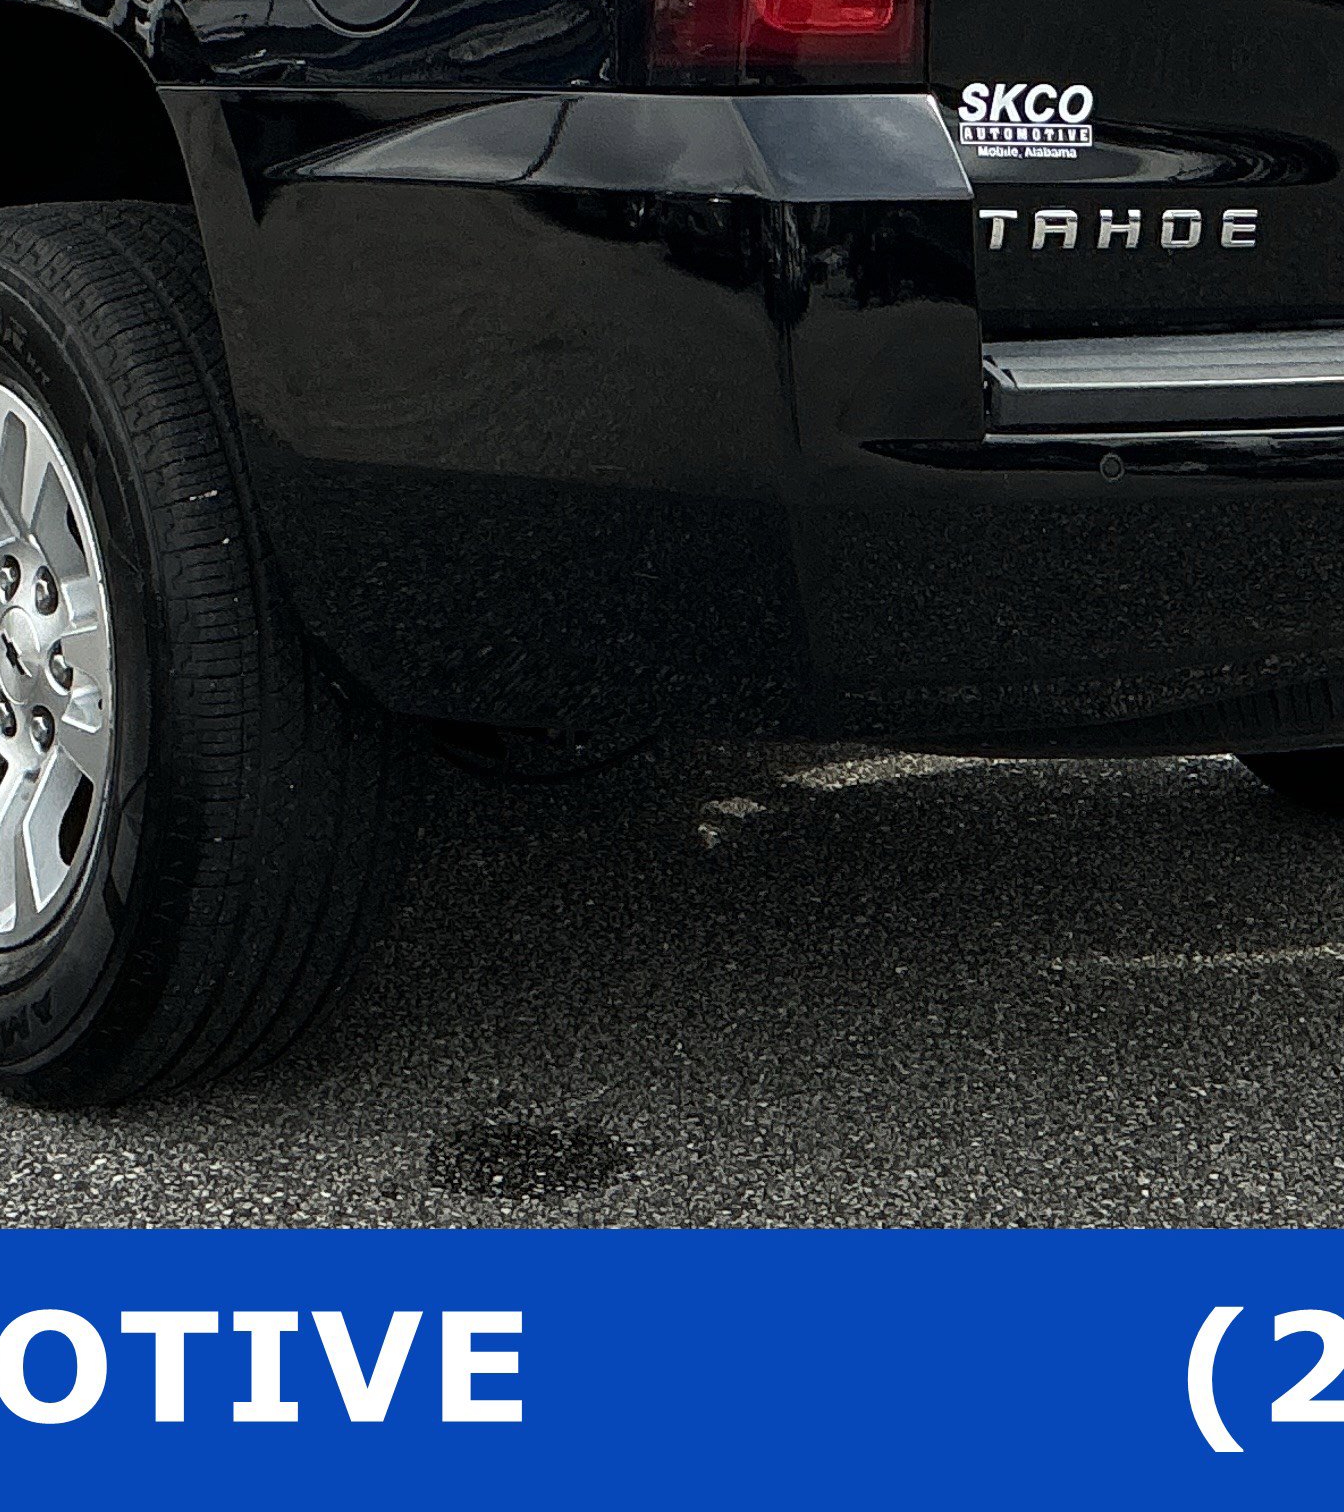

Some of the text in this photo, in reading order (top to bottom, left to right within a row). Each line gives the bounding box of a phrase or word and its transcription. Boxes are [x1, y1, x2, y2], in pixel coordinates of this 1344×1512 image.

[957, 82, 1094, 124] SKCO
[961, 125, 1091, 144] AUTOMOTIVE
[977, 145, 1078, 159] Mobile, Alabama
[978, 207, 1260, 251] TAHOE
